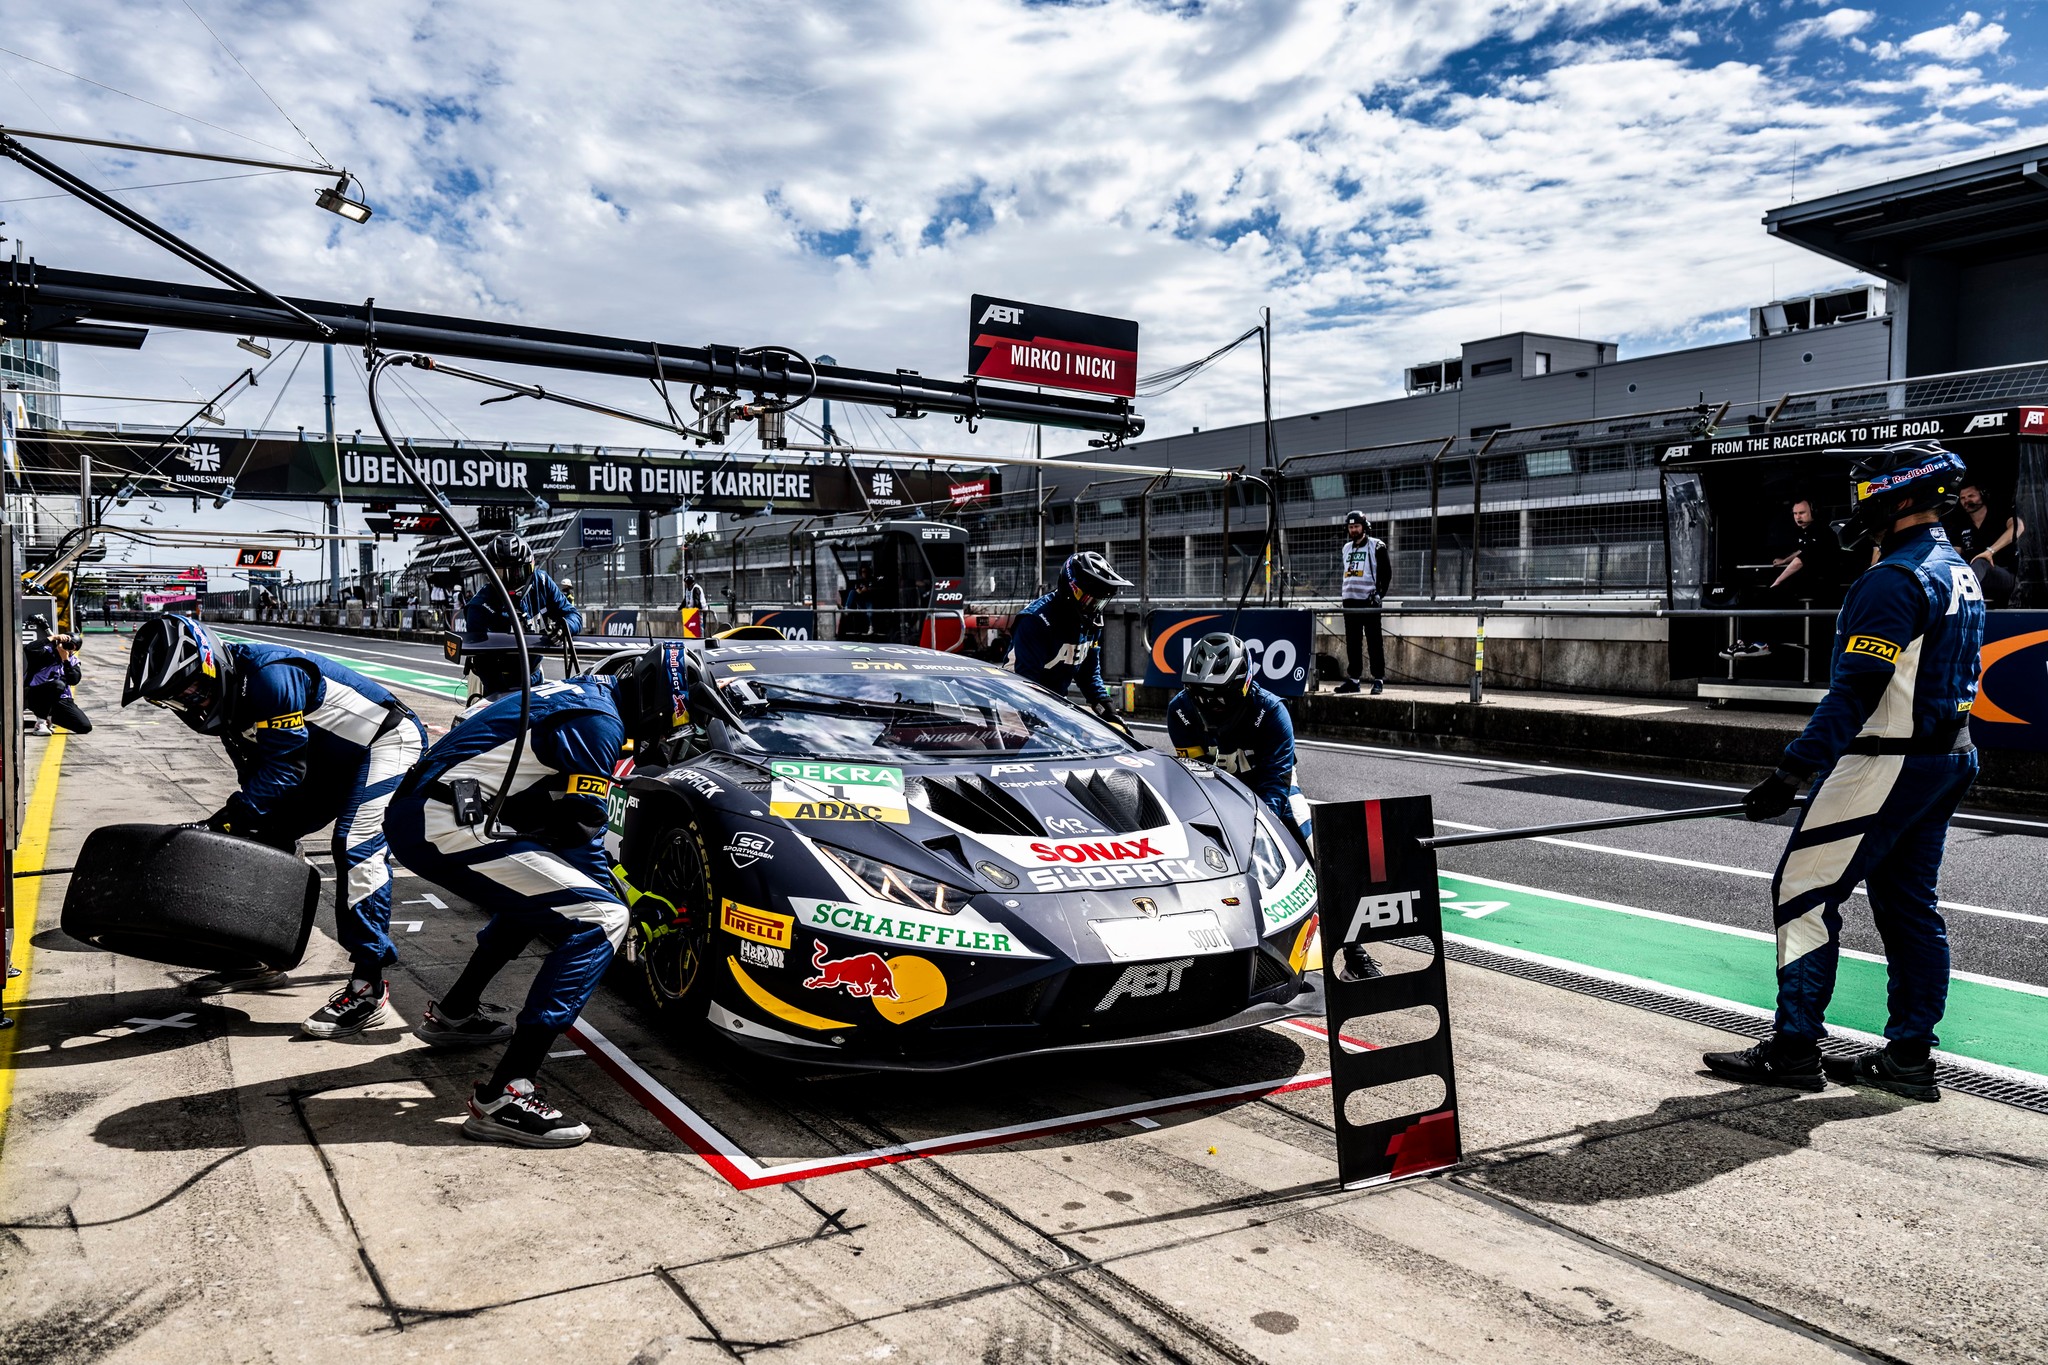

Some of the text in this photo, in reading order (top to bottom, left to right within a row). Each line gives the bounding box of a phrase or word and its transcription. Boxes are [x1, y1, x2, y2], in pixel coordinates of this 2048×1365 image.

[978, 304, 1024, 325] ABT
[1011, 344, 1061, 372] MIRKO
[1075, 354, 1116, 380] NICKI
[1963, 412, 2008, 434] ABT
[2024, 411, 2045, 428] ABT
[1711, 420, 1945, 455] FROM THE RACETRACK TO THE ROAD.
[1661, 445, 1693, 462] ABT
[343, 451, 528, 489] ÜBERHOLSPUR
[175, 474, 235, 484] BUNDESWEHR
[589, 462, 811, 499] FÜR DEINE KARRIERE
[867, 498, 901, 506] UNDESWEHR
[583, 527, 612, 536] Dorint
[921, 531, 950, 539] GT3
[243, 550, 273, 564] 19 63
[936, 592, 963, 602] FORD
[705, 644, 837, 657] FESER
[1856, 639, 1895, 659] DTM
[851, 661, 908, 671] DTM
[912, 664, 982, 673] BORTOLOTTI
[271, 715, 302, 729] DTM
[775, 764, 900, 787] DEKRA
[990, 763, 1039, 778] ABT
[579, 779, 607, 795] DTM
[827, 785, 851, 801] 1
[999, 779, 1058, 790] Capristo
[626, 795, 640, 809] ABT
[794, 803, 883, 820] ADAC
[722, 845, 775, 860] SPORTWAGEN
[737, 837, 766, 851] SG
[1029, 837, 1165, 864] SONAX
[1027, 859, 1210, 893] SÜDPACK
[724, 905, 785, 942] PIRELLI
[1343, 890, 1421, 944] ABT
[811, 903, 1012, 952] SCHAEFFLER
[1093, 956, 1195, 1013] ABT
